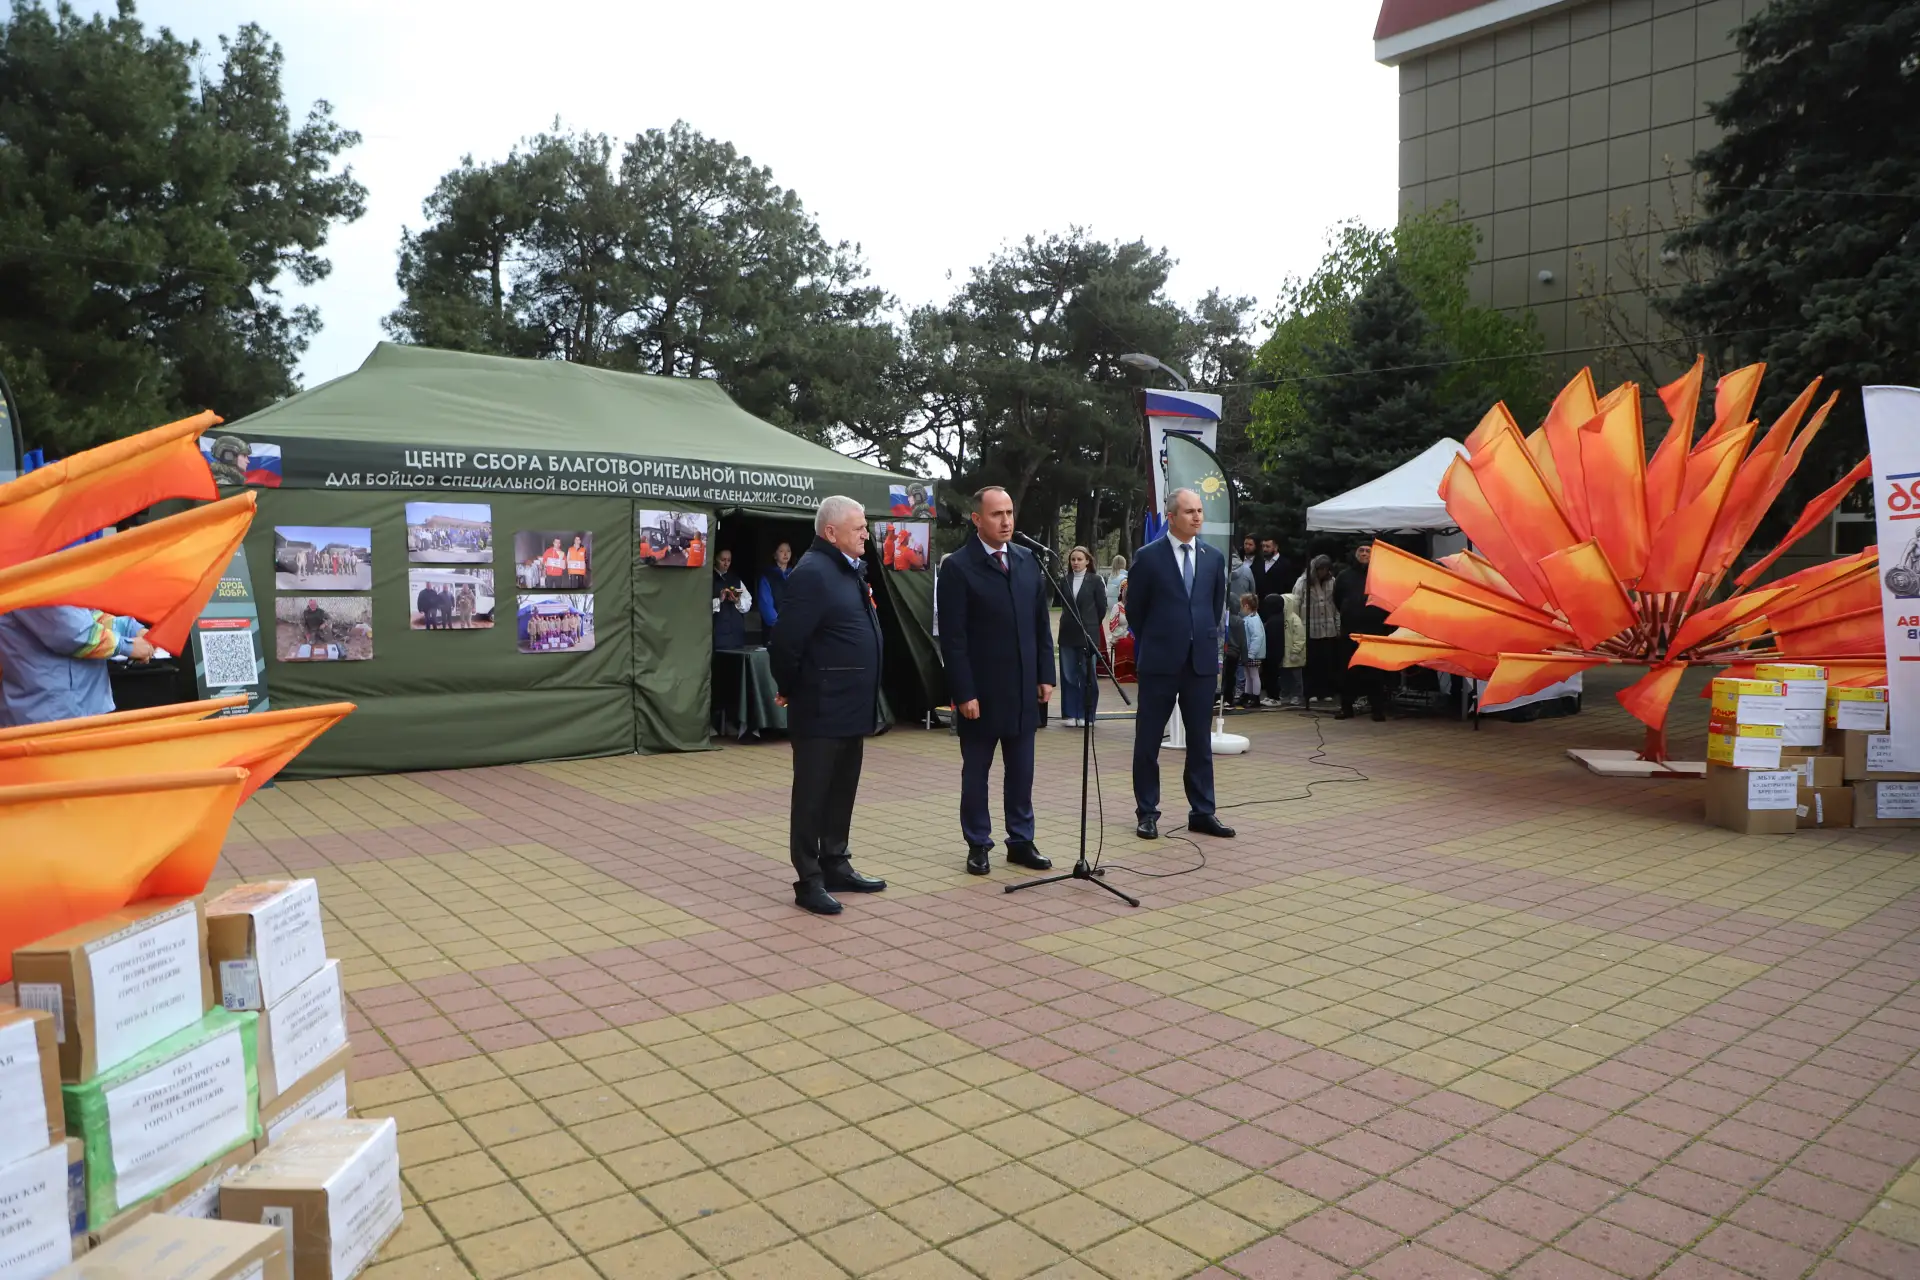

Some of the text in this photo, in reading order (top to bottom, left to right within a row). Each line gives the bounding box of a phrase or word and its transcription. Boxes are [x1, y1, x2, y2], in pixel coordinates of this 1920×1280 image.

[325, 472, 361, 487] ДЛЯ
[366, 470, 435, 487] БОЙЦОВ
[440, 475, 556, 490] СПЕЦИАЛЬНОЙ
[560, 475, 628, 493] ВОЕННОЙ
[632, 481, 701, 498] ОПЕРАЦИИ
[405, 450, 814, 491] ЦЕНТР СБОРА БЛАГОТВОРИТЕЛЬНОЙ ПОМОЩИ
[219, 589, 249, 597] ДОБРА
